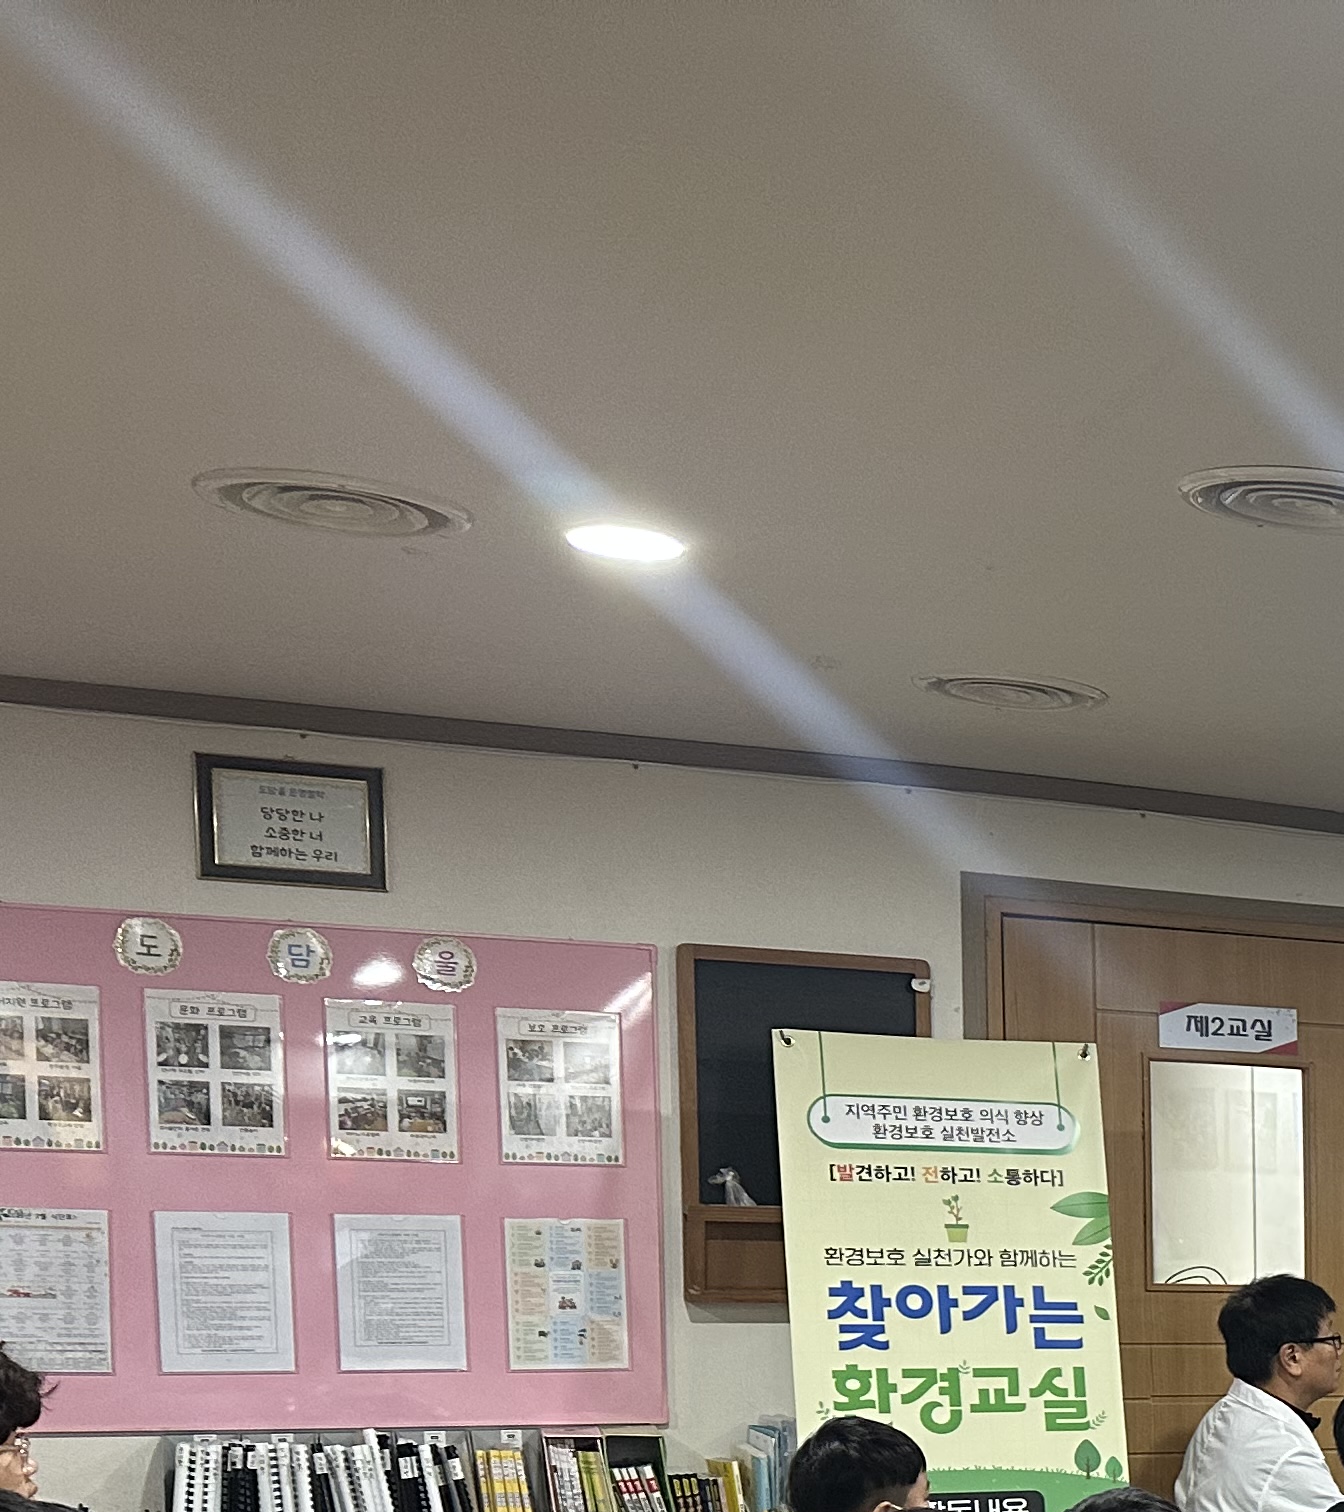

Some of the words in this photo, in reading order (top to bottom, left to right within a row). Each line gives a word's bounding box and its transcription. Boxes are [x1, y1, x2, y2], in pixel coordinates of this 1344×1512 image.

[260, 806, 305, 823] 당당한
[309, 811, 325, 823] 나
[264, 826, 305, 842] 소중한
[309, 831, 324, 842] 너
[250, 845, 308, 862] 함께하는
[312, 849, 339, 863] 우리
[136, 934, 162, 958] 도
[287, 943, 316, 970] 담
[434, 950, 459, 977] 울
[206, 1006, 247, 1018] 프로그램
[358, 1014, 377, 1025] 교육
[383, 1015, 422, 1028] 프로그램
[1186, 1015, 1273, 1042] 제2교실
[845, 1102, 908, 1121] 지역주민
[912, 1105, 976, 1123] 환경보호
[979, 1108, 1010, 1125] 의식
[1013, 1109, 1045, 1127] 향상
[872, 1123, 936, 1141] 환경보호
[940, 1126, 1018, 1144] 실천발전소
[829, 1164, 916, 1183] [발견하고!
[921, 1166, 982, 1185] 전하고!
[987, 1168, 1065, 1188] 소통하다]
[824, 1247, 907, 1268] 환경보호
[912, 1248, 994, 1268] 실천가와
[998, 1249, 1078, 1269] 함께하는
[827, 1280, 1085, 1351] 찾아가는
[832, 1364, 1091, 1435] 환경교실
